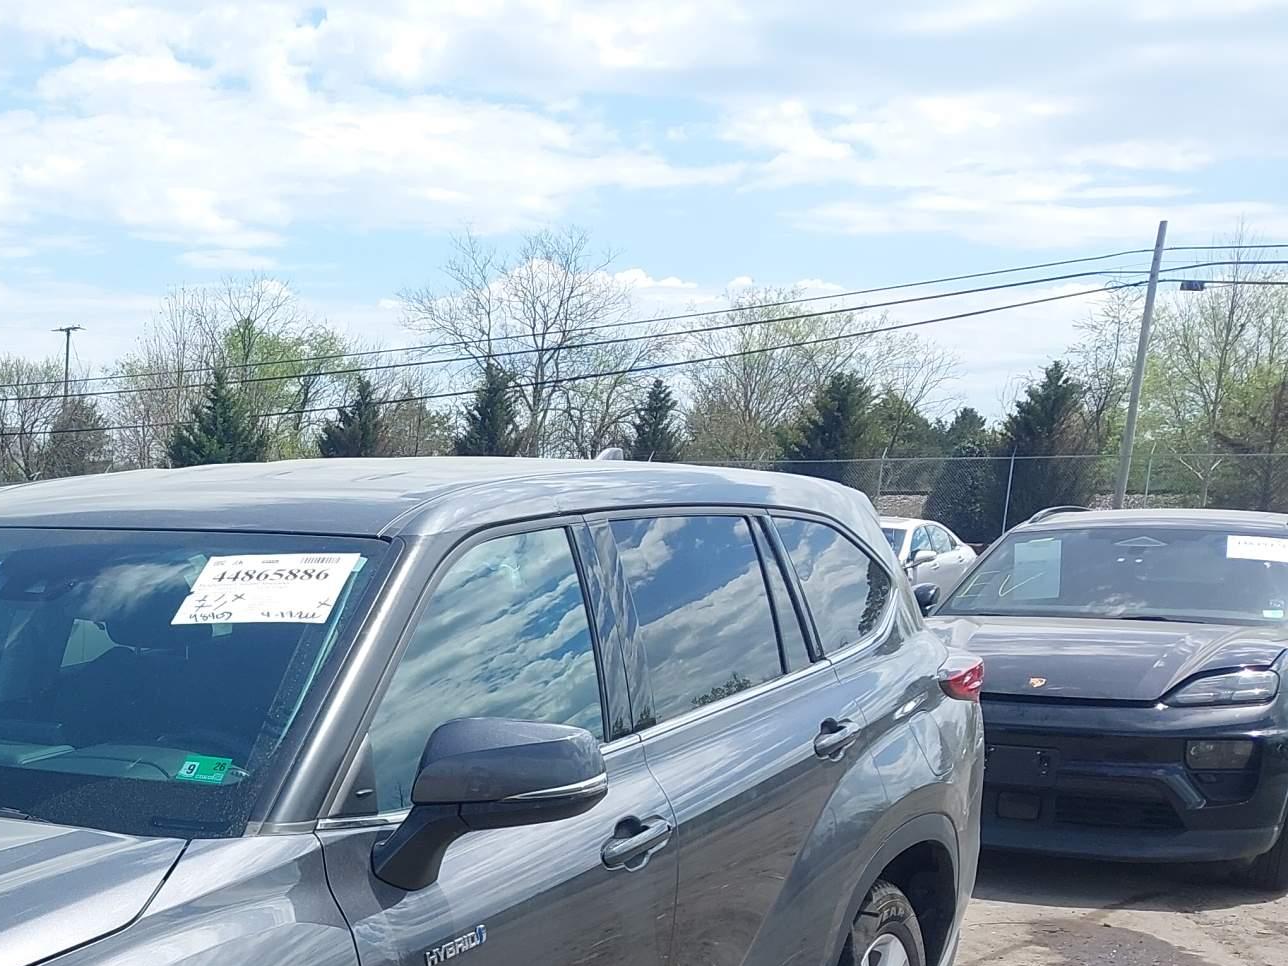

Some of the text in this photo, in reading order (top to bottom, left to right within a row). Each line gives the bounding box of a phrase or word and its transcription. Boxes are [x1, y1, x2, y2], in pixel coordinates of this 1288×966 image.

[213, 568, 330, 583] 44865886
[185, 763, 197, 775] 9
[213, 761, 228, 772] 26
